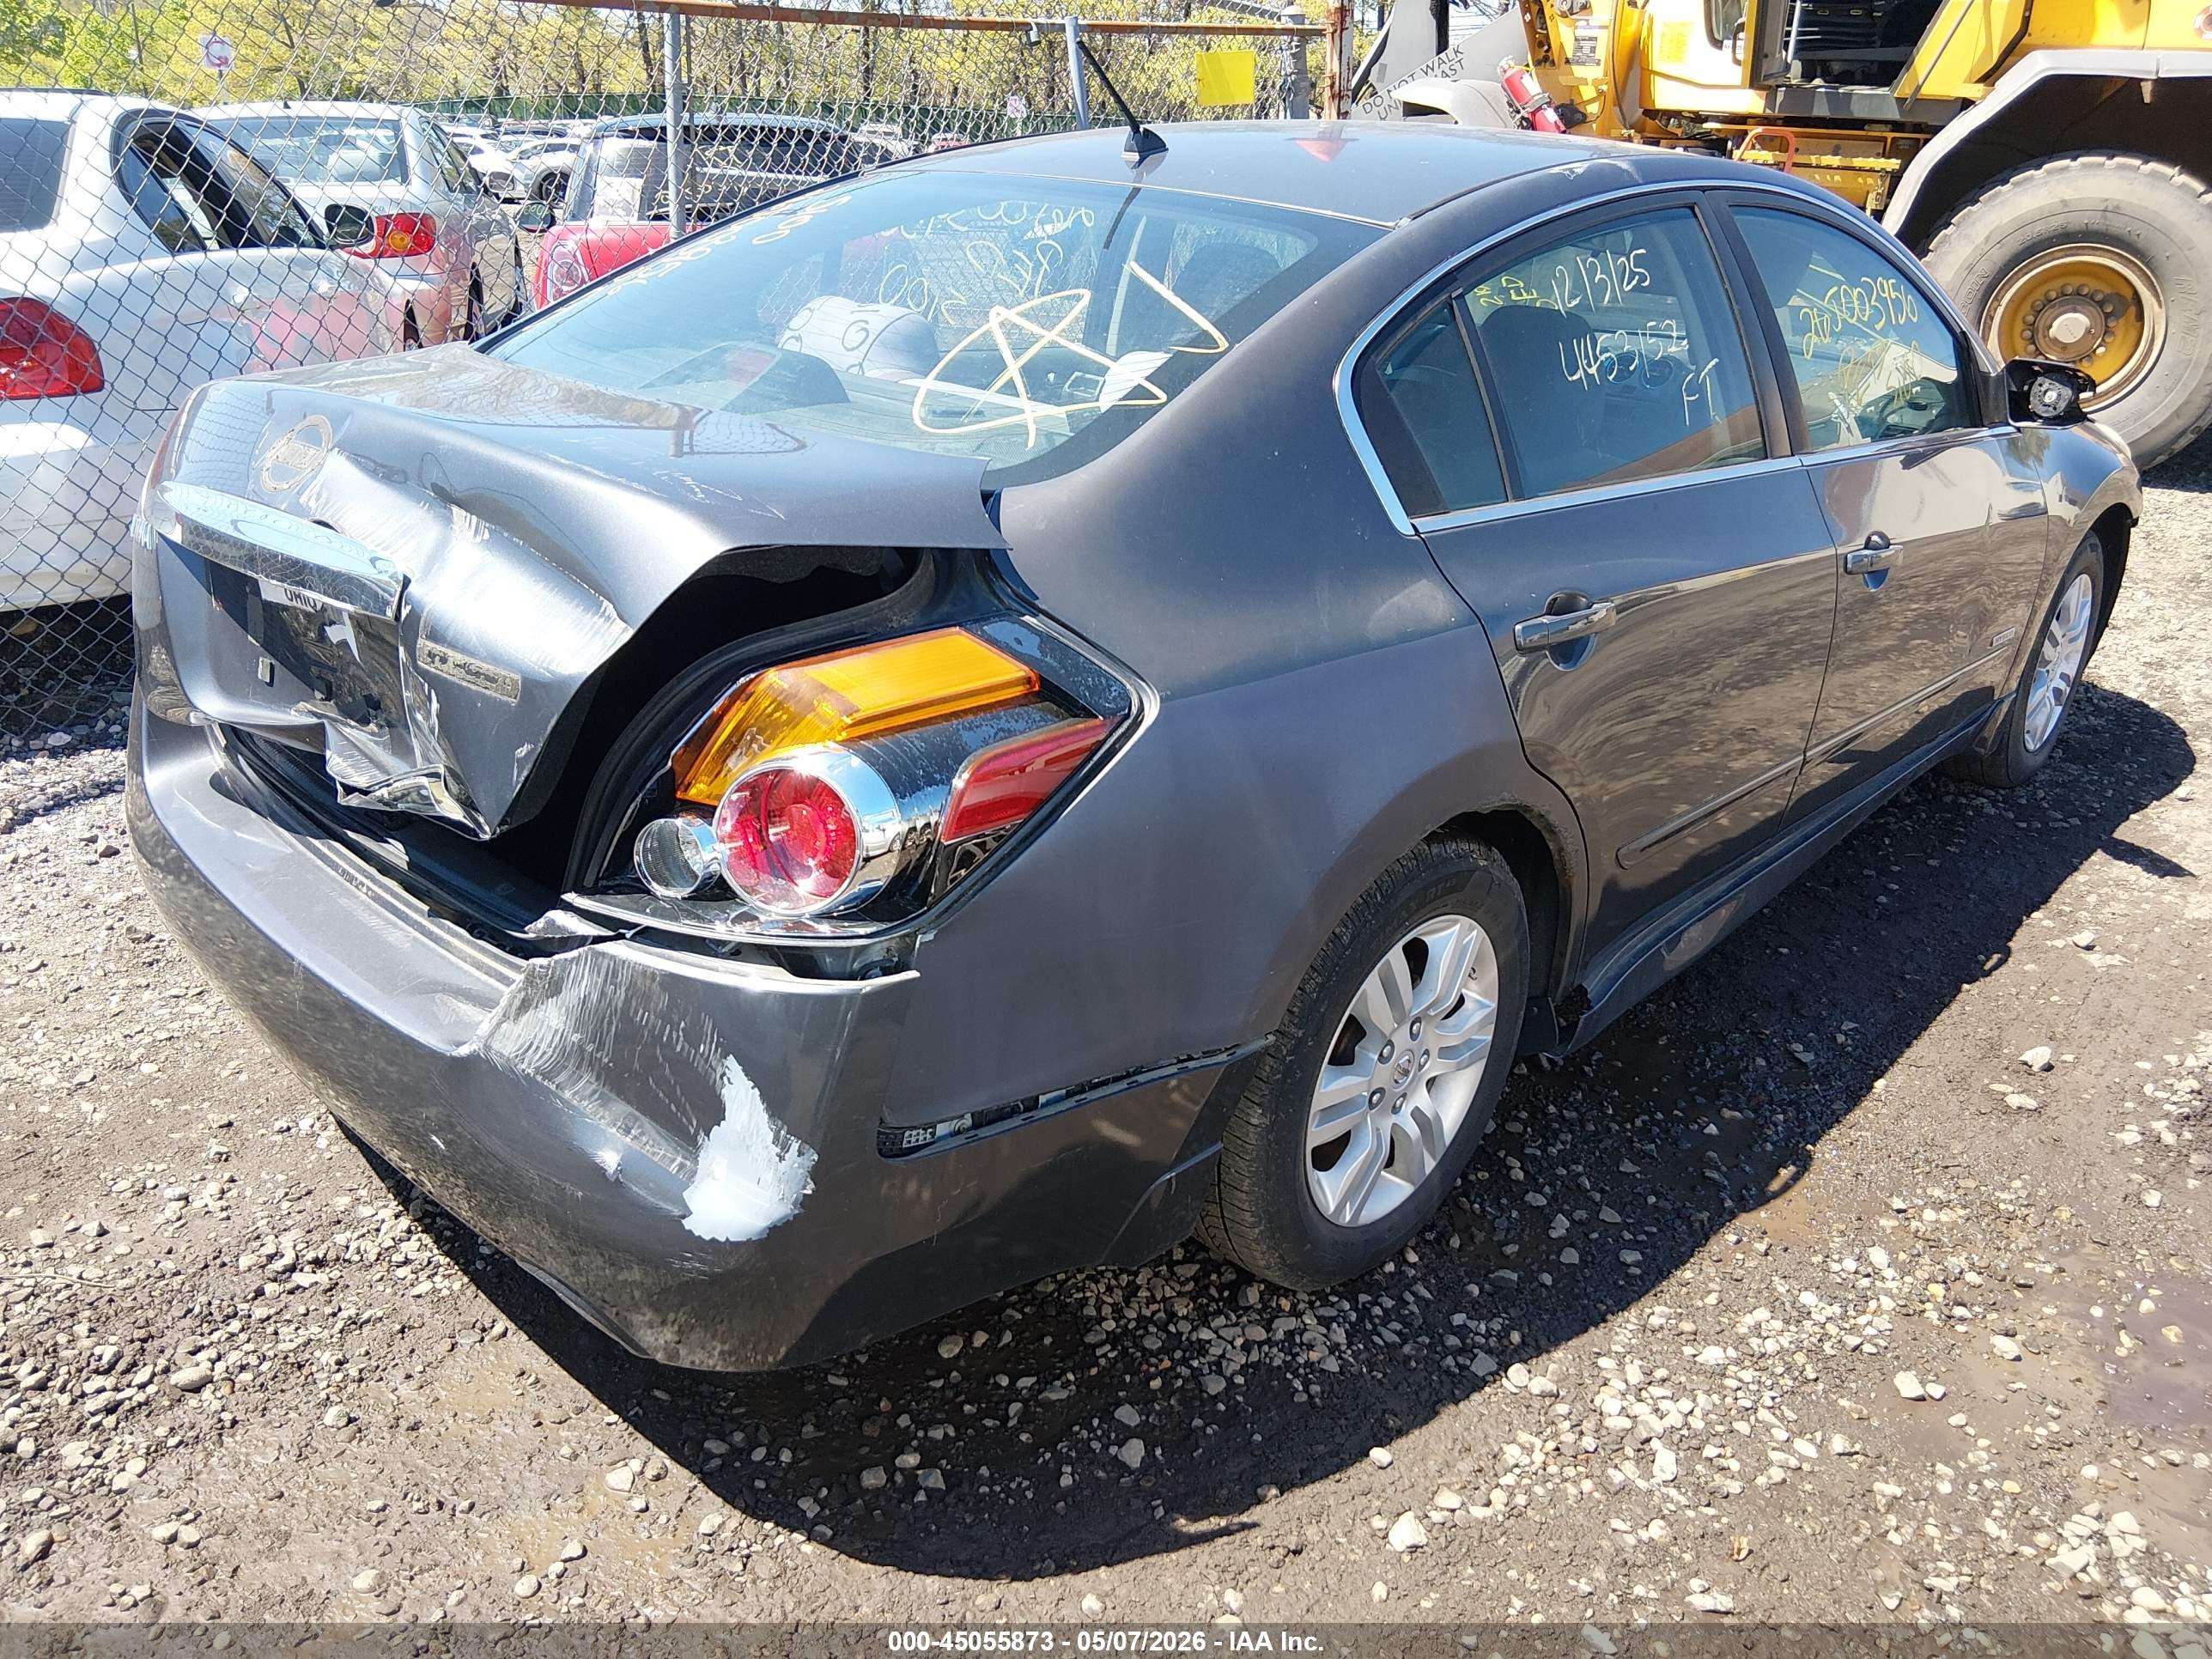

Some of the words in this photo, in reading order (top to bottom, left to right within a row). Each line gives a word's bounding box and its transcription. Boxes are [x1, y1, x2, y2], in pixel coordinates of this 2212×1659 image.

[1362, 94, 1384, 114] DO
[1420, 45, 1463, 76] WALK
[1551, 248, 1650, 319] 12/3/25
